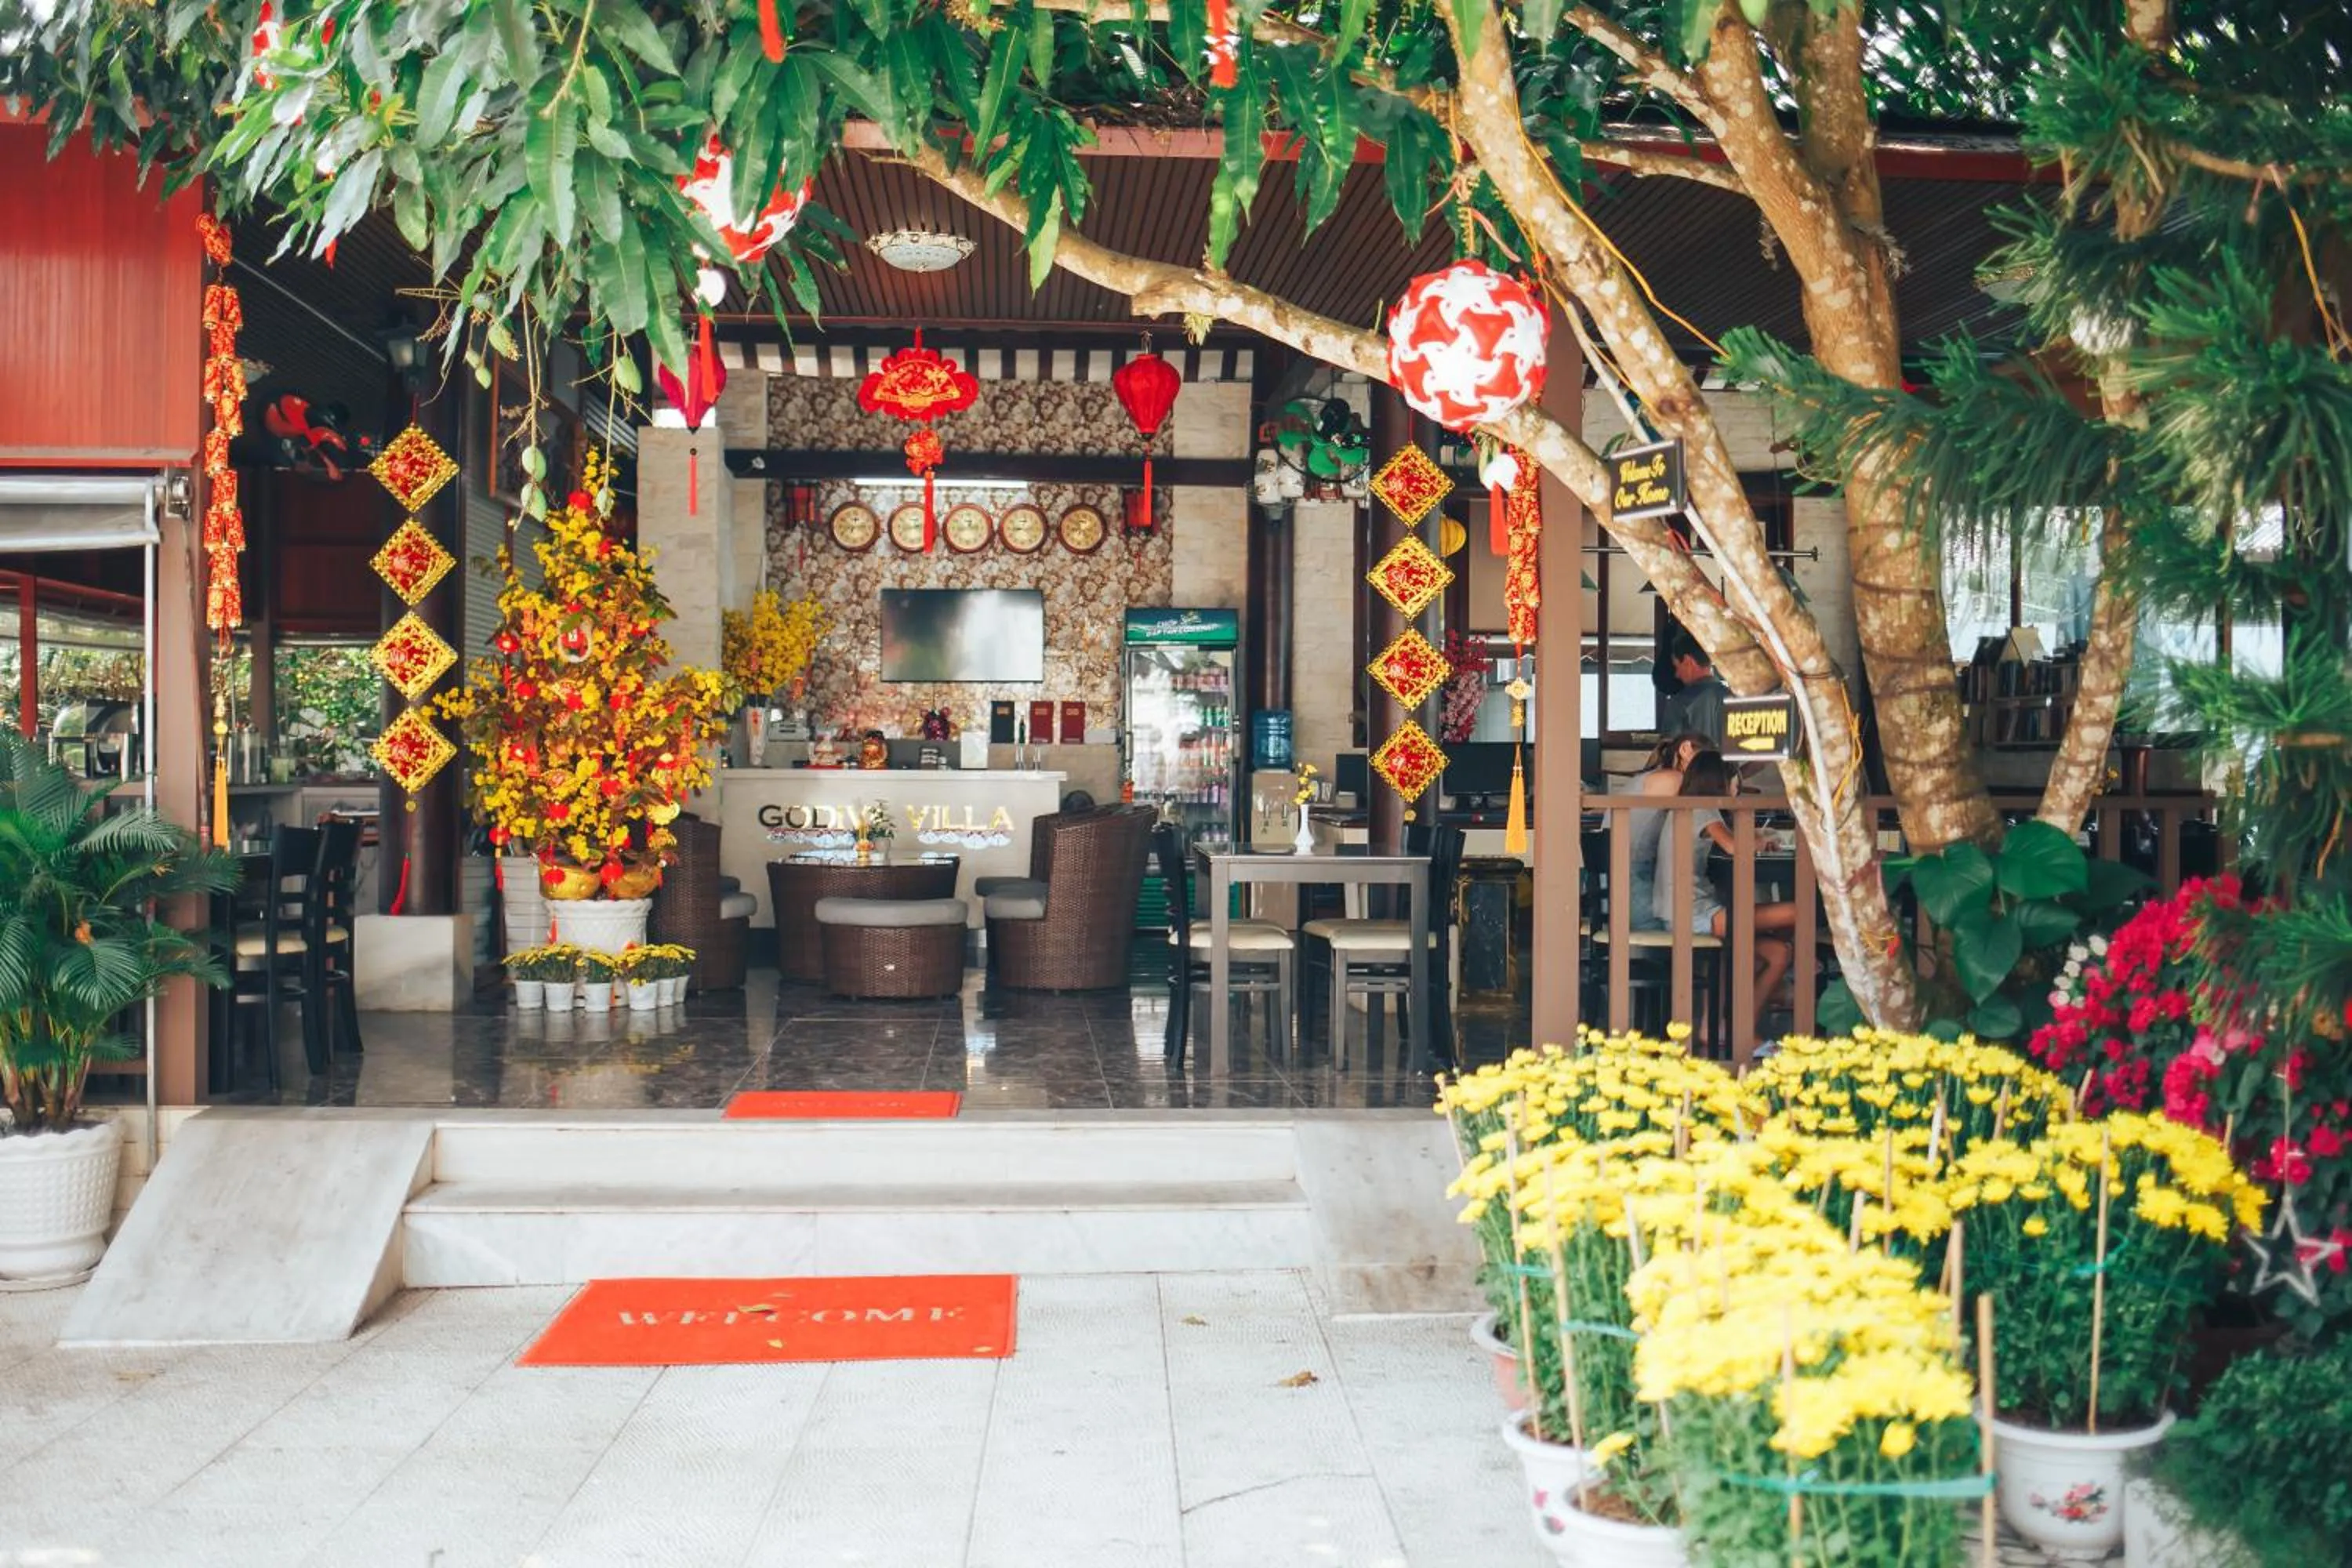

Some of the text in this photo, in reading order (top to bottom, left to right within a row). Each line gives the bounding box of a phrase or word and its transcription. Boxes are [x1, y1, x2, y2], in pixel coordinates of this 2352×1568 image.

[1636, 481, 1670, 506] Home
[1727, 709, 1787, 737] RECEPTION
[758, 804, 1014, 830] GODIV VILLA
